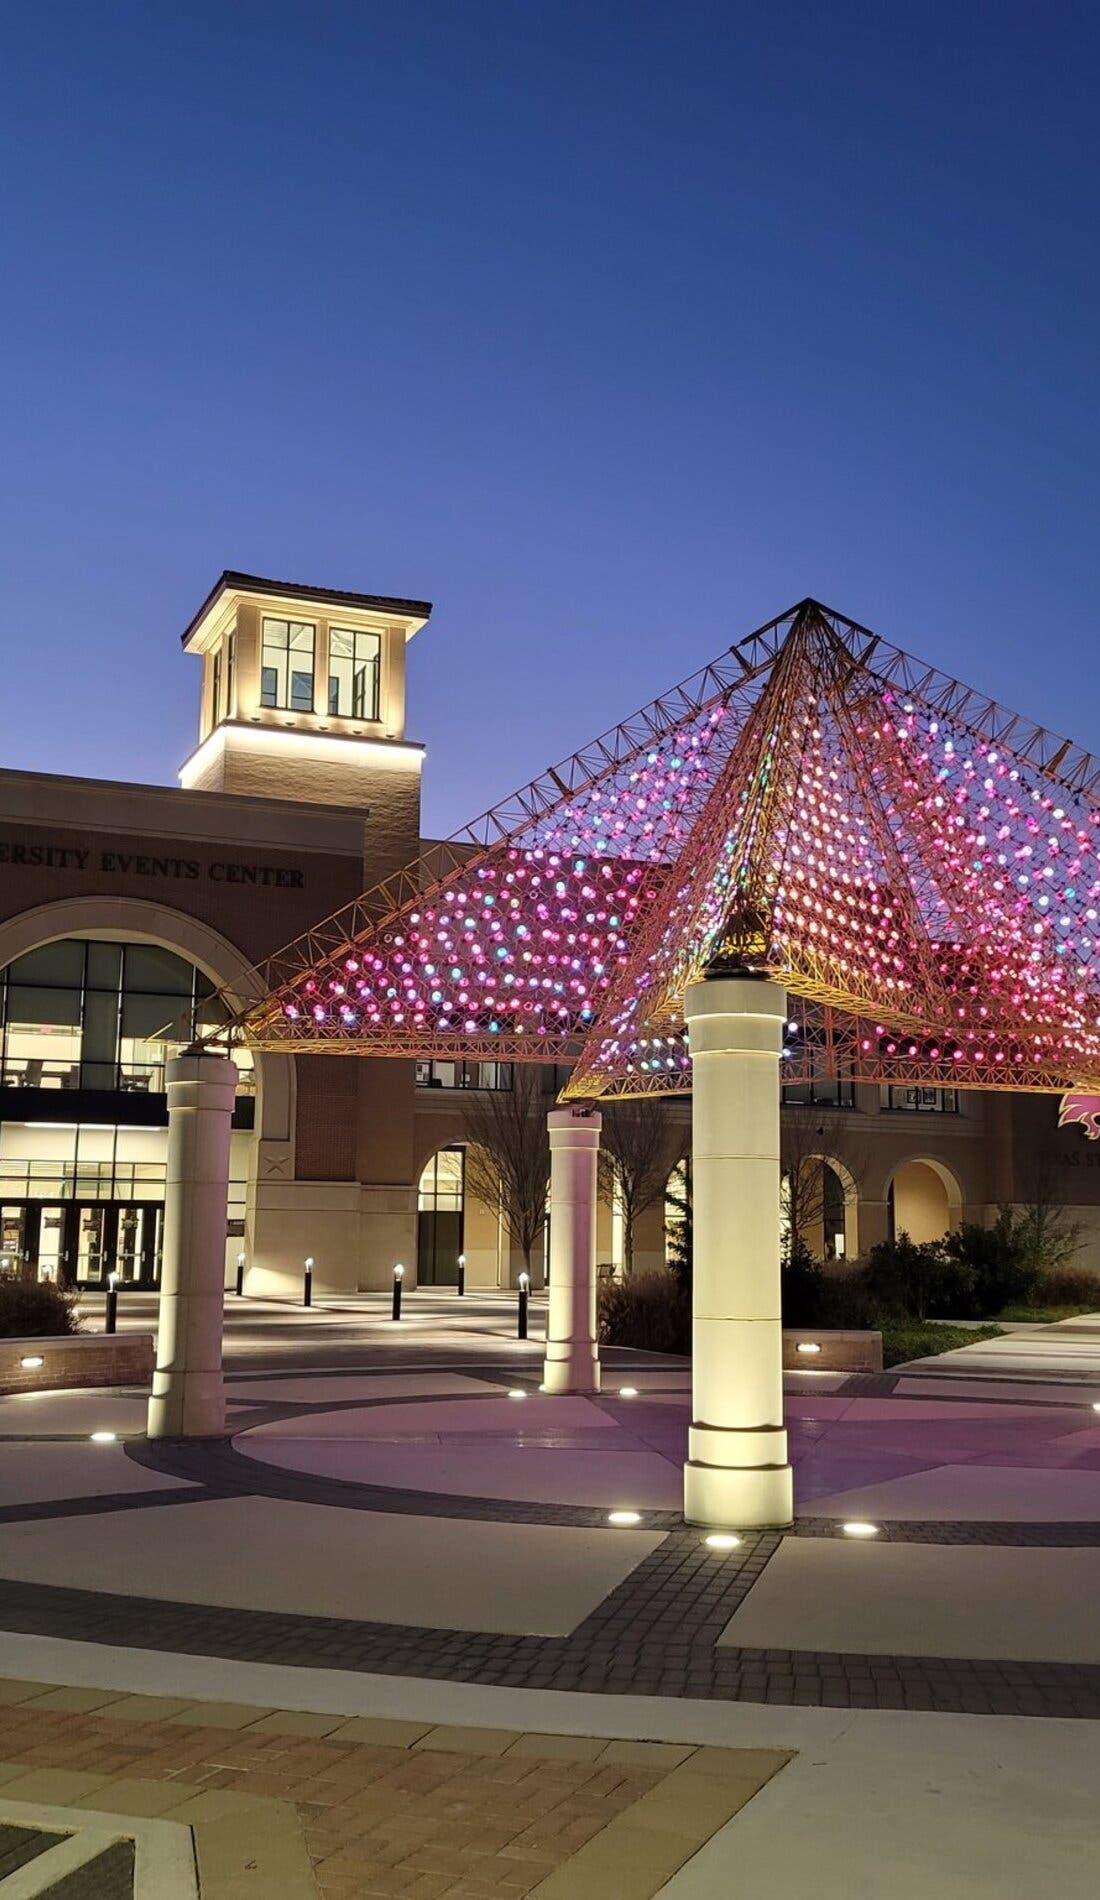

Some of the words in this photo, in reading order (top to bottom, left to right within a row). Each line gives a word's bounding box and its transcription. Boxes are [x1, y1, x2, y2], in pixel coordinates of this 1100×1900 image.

[0, 842, 89, 868] ERSITY
[100, 852, 200, 880] EVENTS
[208, 861, 304, 888] CENTER
